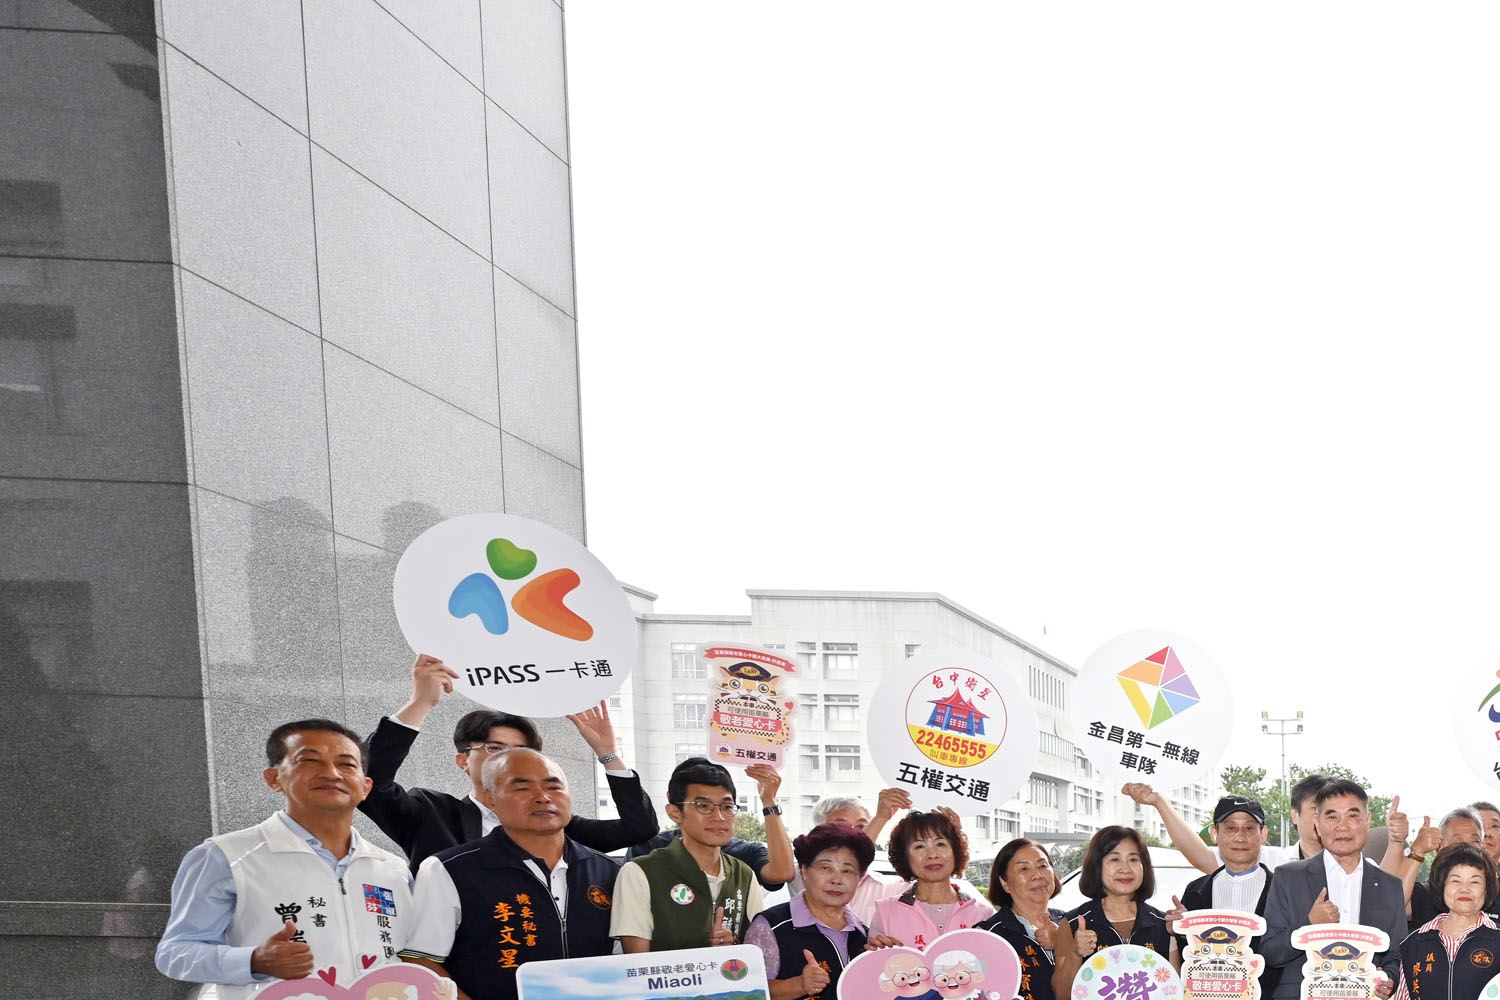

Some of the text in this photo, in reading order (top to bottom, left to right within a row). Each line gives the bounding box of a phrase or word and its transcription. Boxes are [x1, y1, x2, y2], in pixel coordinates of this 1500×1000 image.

[466, 659, 613, 686] iPASS 一卡通
[931, 672, 992, 700] 台中衛星
[720, 714, 777, 731] 敬老愛心卡
[735, 748, 777, 761] 五權交通
[916, 729, 987, 759] 22465555
[1088, 721, 1200, 765] 金昌第一無線
[1120, 751, 1157, 775] 車隊
[896, 762, 990, 802] 五權交通
[307, 896, 327, 927] 秘書
[493, 902, 521, 968] 李文星
[625, 961, 718, 978] 苗栗縣敬老愛心卡
[647, 974, 702, 990] Miaoli
[1192, 980, 1242, 991] 敬老愛心卡
